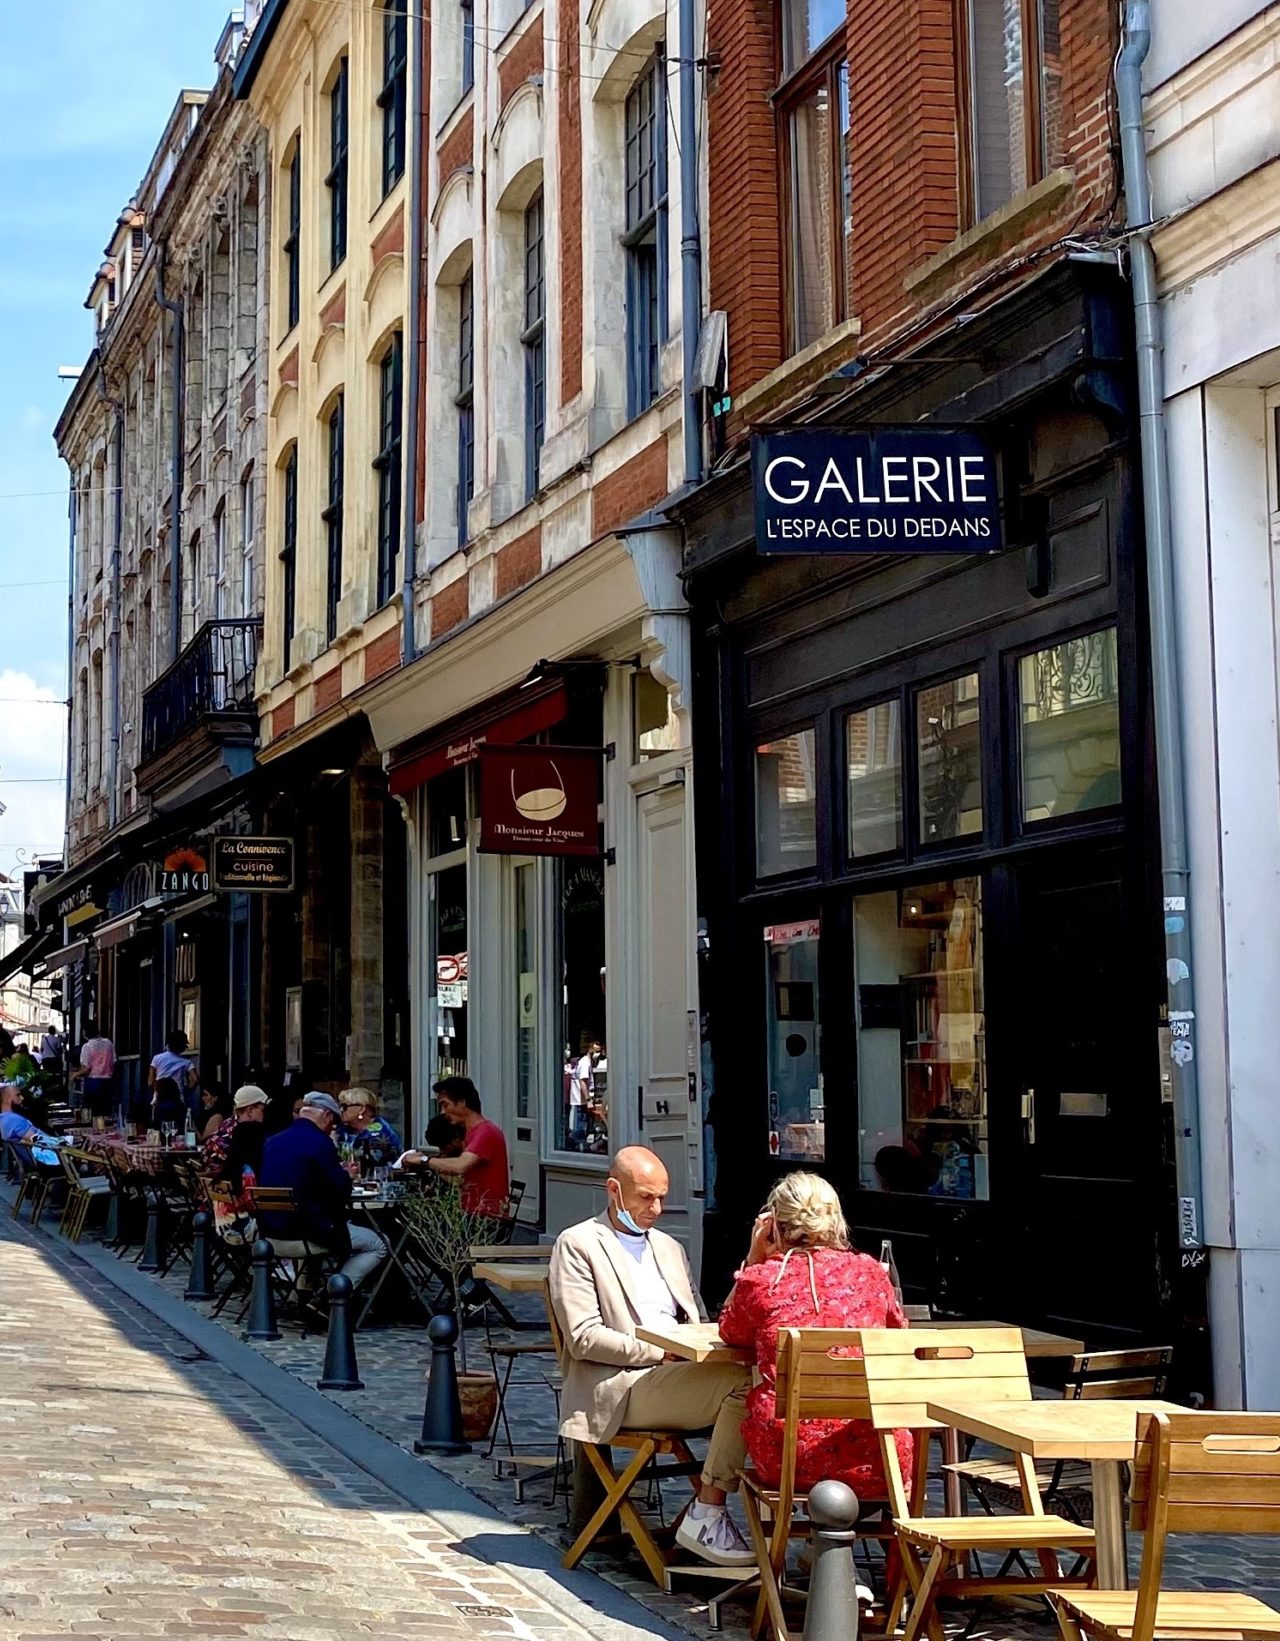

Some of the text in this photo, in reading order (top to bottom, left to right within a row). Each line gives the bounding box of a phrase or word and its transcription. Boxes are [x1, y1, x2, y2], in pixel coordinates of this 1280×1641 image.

[764, 456, 987, 504] GALERIE
[767, 517, 991, 538] L'ESPACE DU DEDANS
[494, 823, 544, 836] Monsieur
[546, 826, 585, 839] Jacques
[221, 841, 287, 854] La Connivence
[233, 861, 274, 873] cuisine
[162, 872, 210, 891] ZANGO
